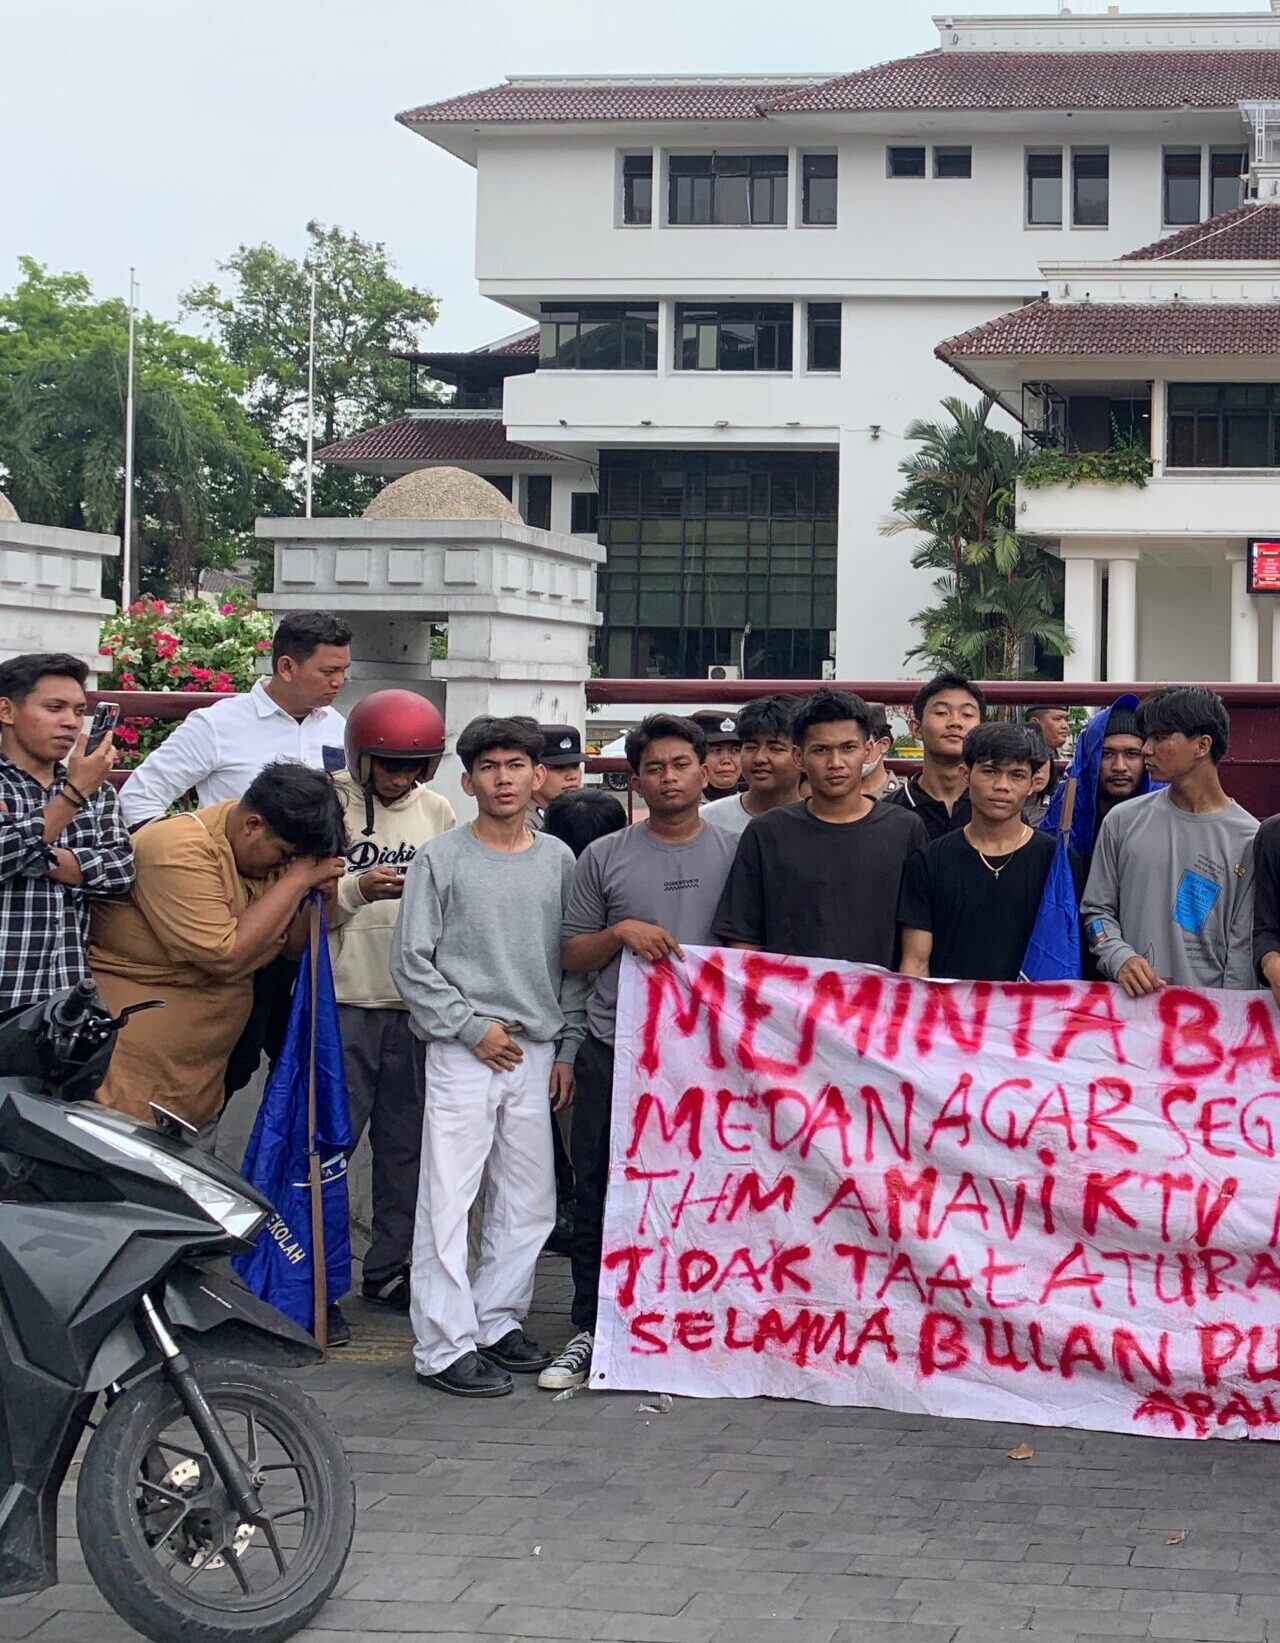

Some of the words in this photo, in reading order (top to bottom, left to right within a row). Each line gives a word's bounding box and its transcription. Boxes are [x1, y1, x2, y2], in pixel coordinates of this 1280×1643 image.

[347, 840, 417, 872] Dicki
[640, 954, 1126, 1077] MEMINTA
[625, 1082, 914, 1167] MEDAN
[924, 1073, 1138, 1153] AGAR
[624, 1166, 795, 1234] THM
[1082, 1169, 1239, 1248] KTV
